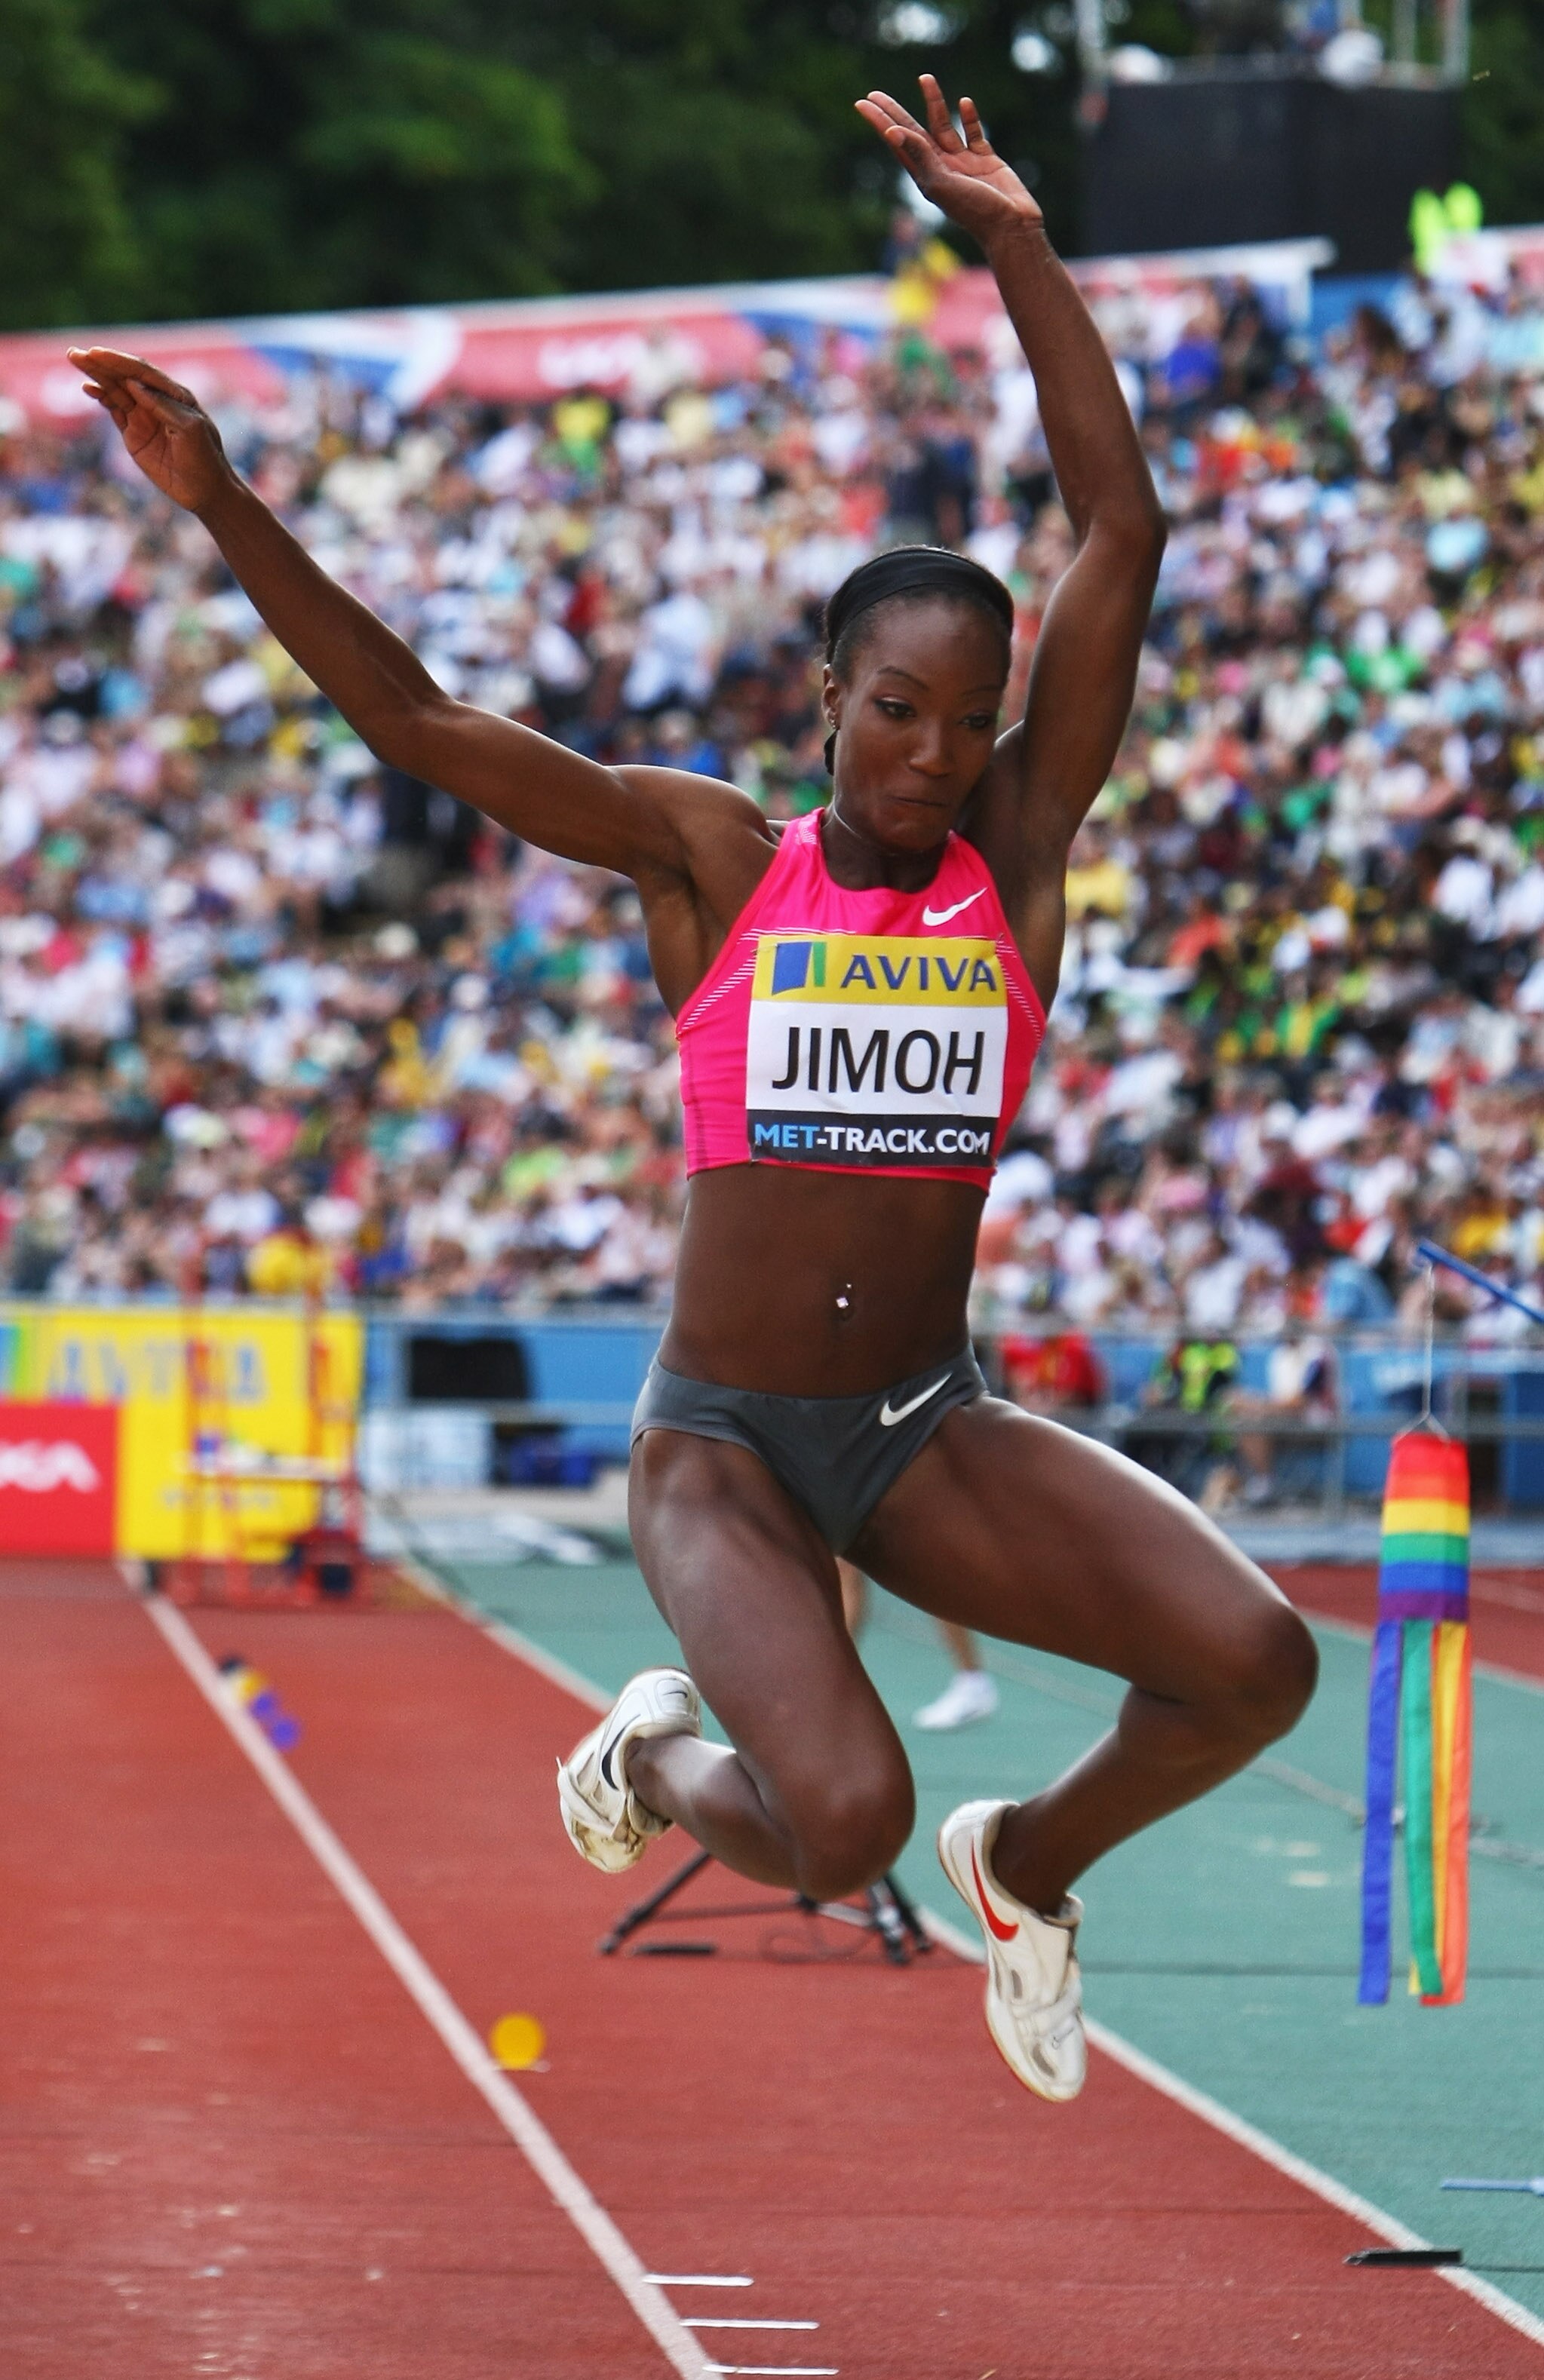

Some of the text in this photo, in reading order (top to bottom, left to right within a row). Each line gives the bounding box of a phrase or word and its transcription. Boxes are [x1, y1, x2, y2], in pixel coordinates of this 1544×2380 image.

[840, 954, 997, 992] AVIVA
[772, 1026, 985, 1095] JIMOH
[754, 1124, 990, 1155] MET-TRACK.COM
